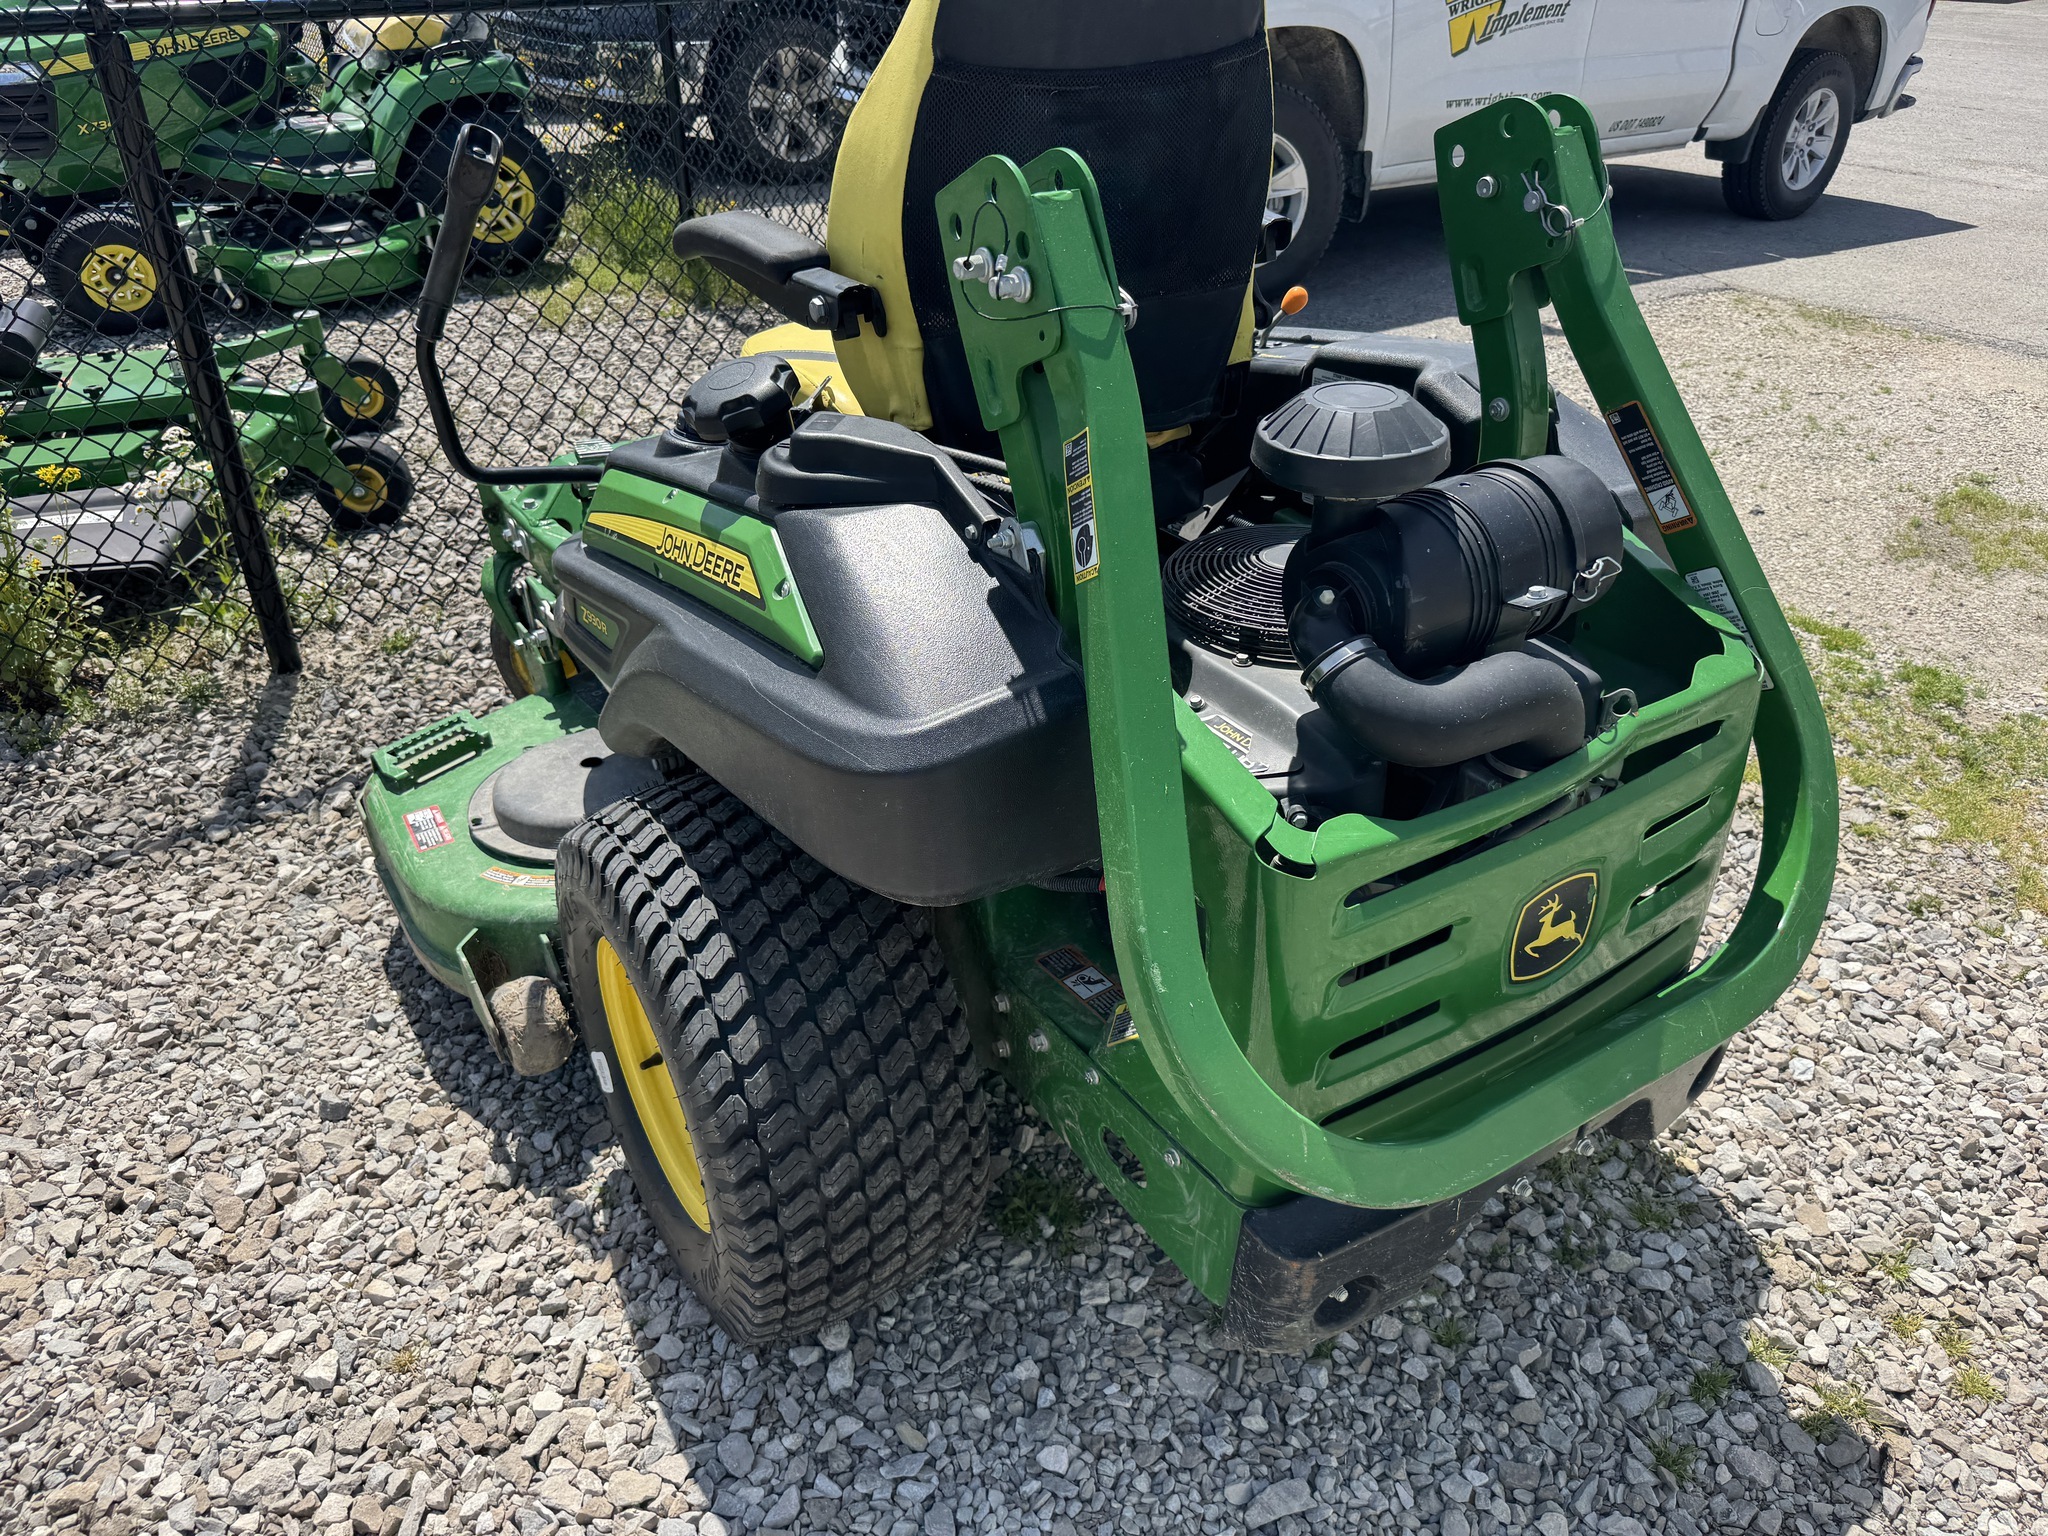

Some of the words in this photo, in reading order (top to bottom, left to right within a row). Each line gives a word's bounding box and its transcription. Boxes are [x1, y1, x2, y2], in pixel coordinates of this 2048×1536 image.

[1449, 0, 1490, 17] WRIG
[1480, 0, 1571, 39] Implement
[146, 39, 187, 58] JOHN
[189, 30, 239, 51] DEERE
[1445, 91, 1552, 109] www.wrightipcom
[656, 527, 692, 564] JOHN
[693, 540, 745, 587] DEERE
[581, 606, 608, 636] Z930R
[1214, 723, 1243, 742] JOHN
